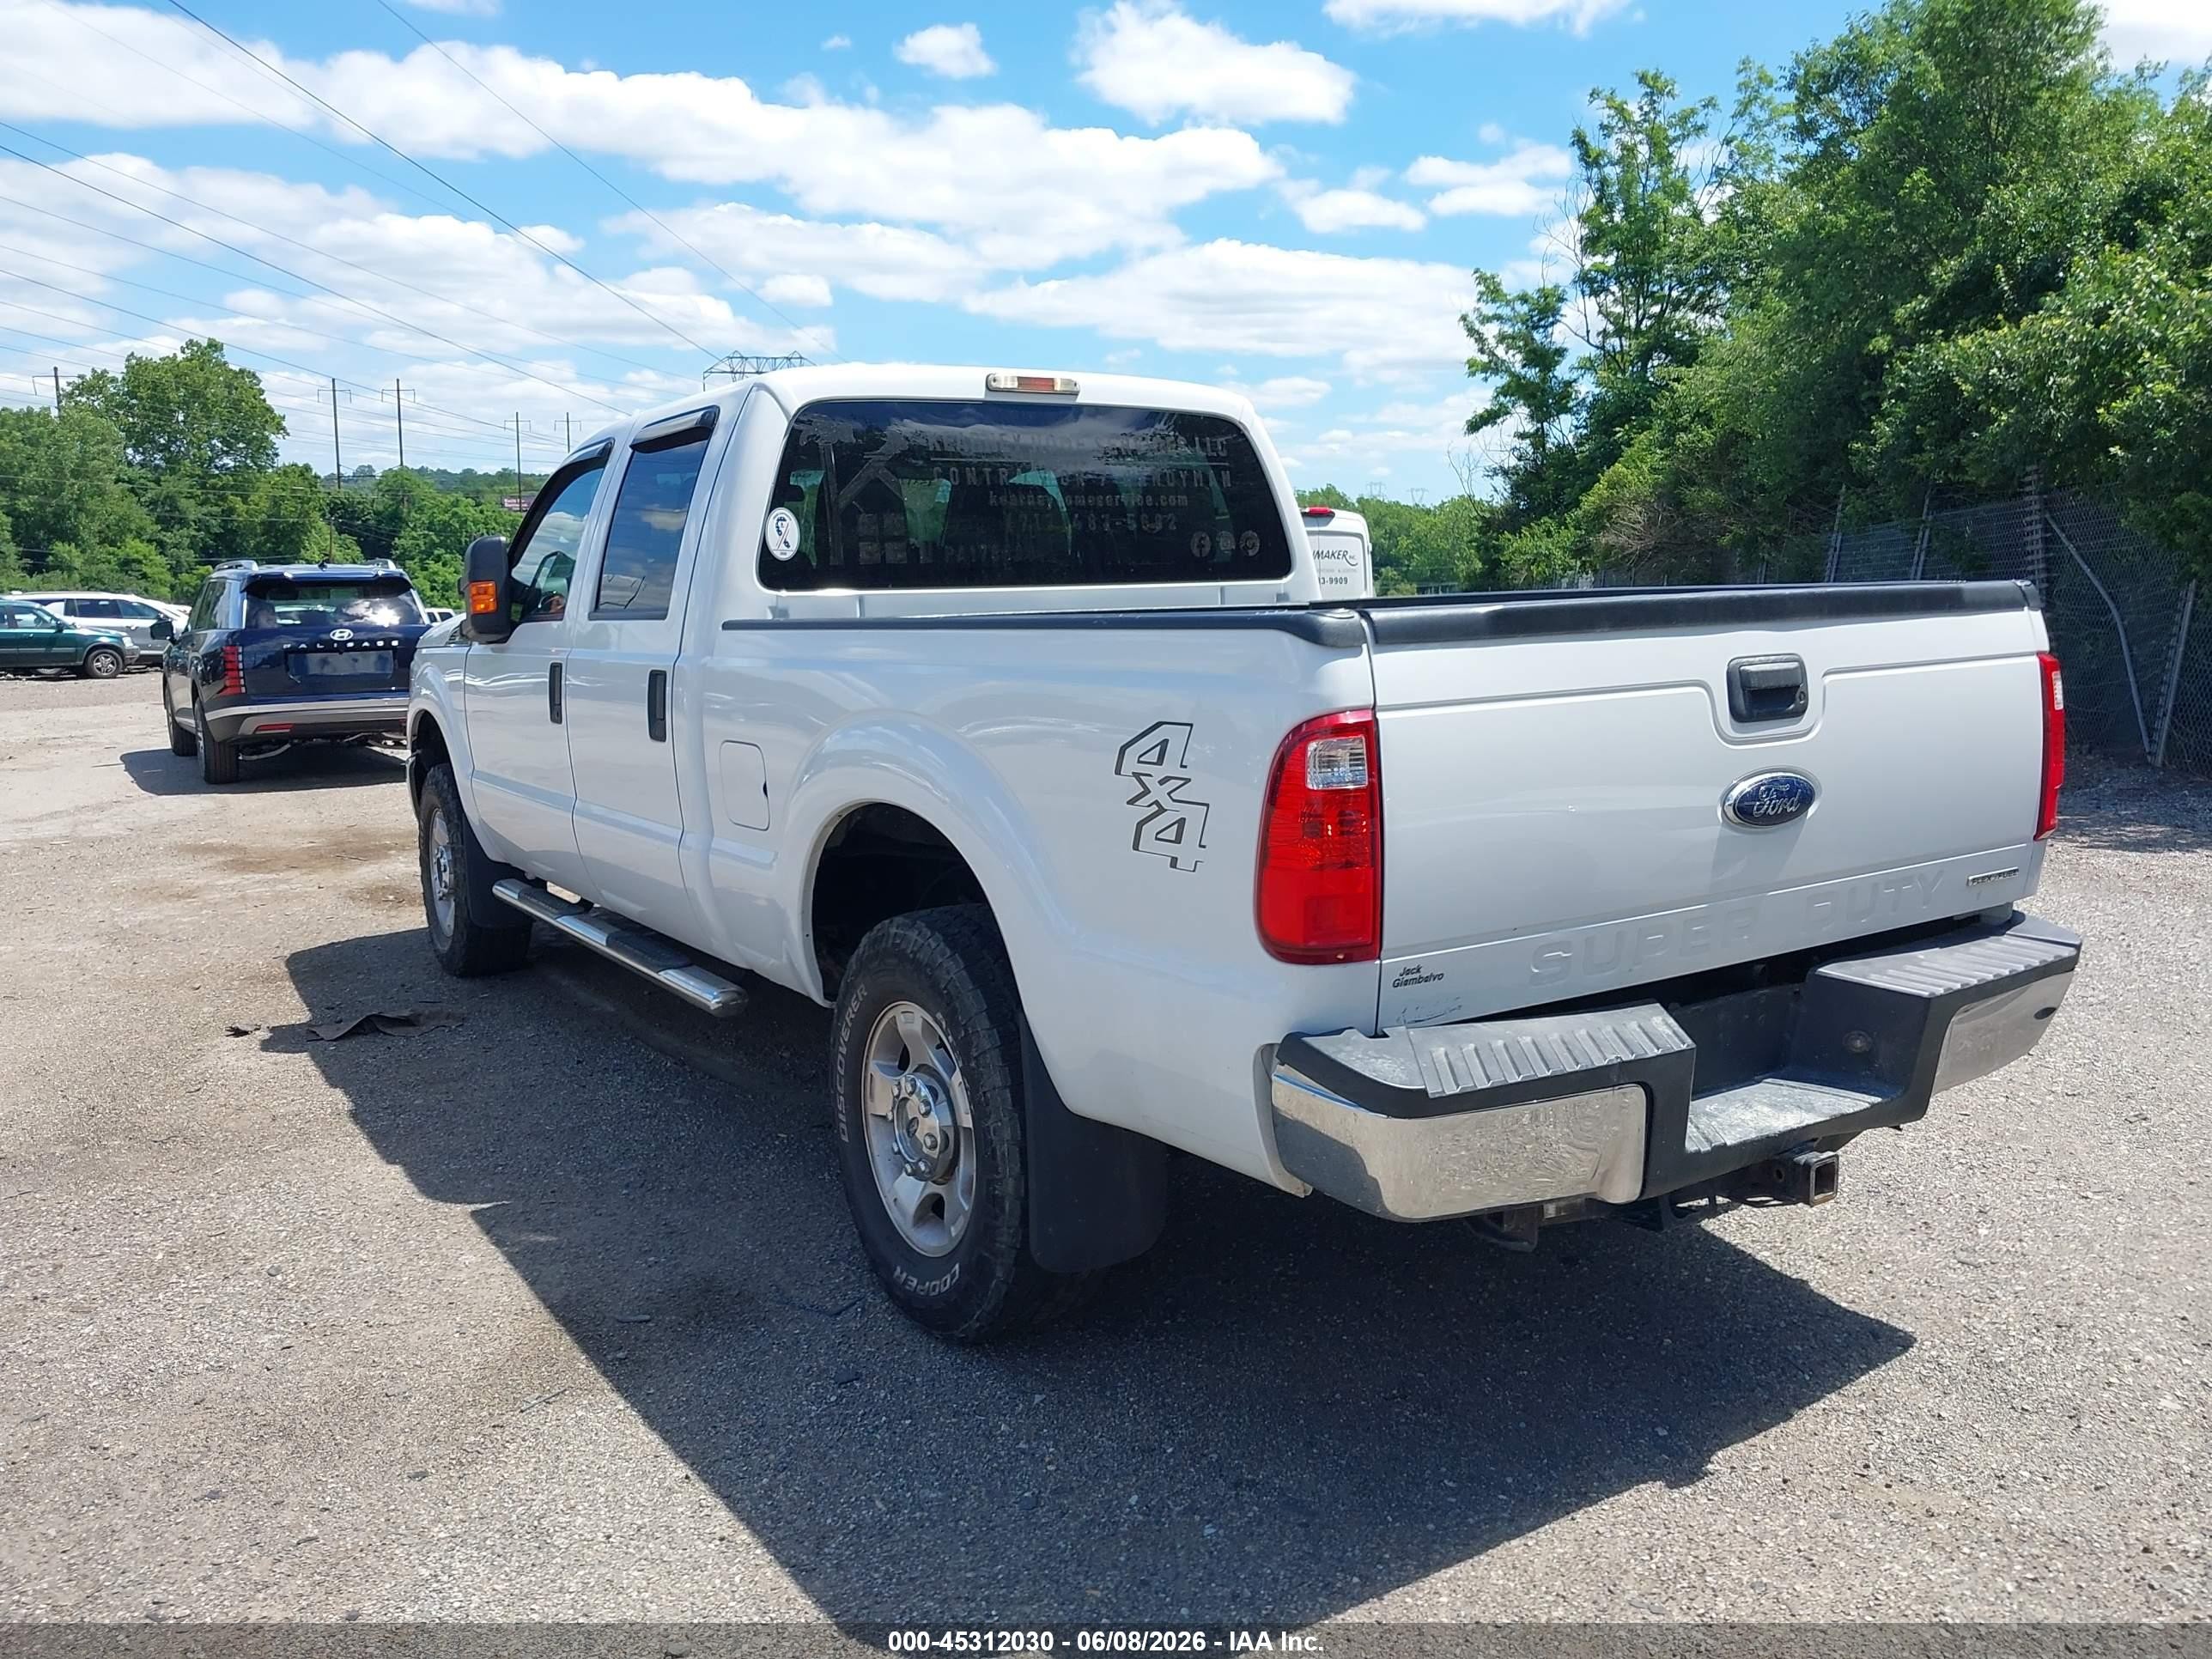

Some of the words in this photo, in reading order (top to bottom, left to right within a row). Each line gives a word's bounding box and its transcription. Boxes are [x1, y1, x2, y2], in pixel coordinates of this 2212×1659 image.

[989, 490, 1188, 508] kearneyomeservice.com
[1753, 783, 1802, 817] Ford
[1528, 905, 1759, 987] SUPER
[1802, 869, 1945, 934] DUTY
[1392, 973, 1444, 988] Giambalvo
[1399, 964, 1422, 977] Jack
[836, 983, 868, 1143] DISCOVERER
[893, 1262, 960, 1297] COOPER
